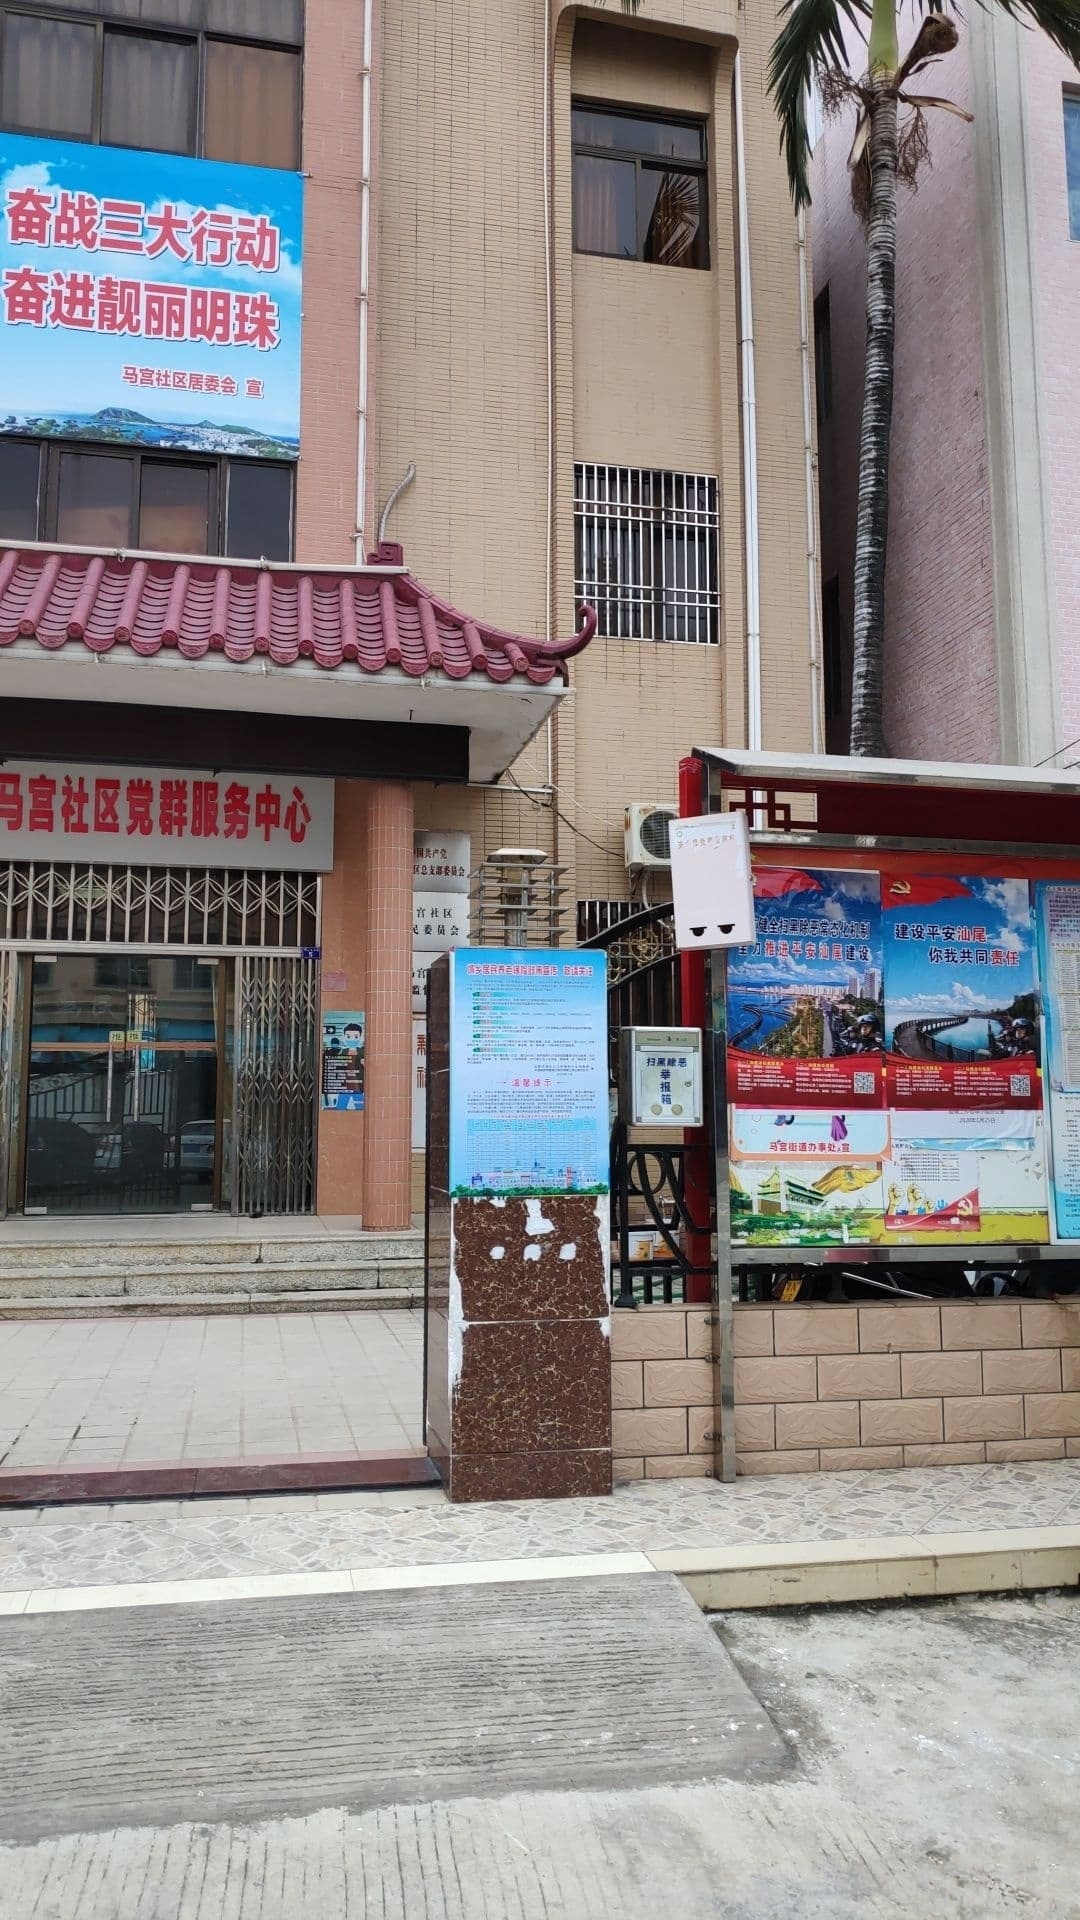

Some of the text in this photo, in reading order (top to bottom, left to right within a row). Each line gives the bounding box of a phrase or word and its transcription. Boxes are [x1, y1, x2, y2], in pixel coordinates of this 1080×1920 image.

[6, 186, 279, 271] 奋战三大行动
[3, 267, 278, 349] 奋进靓丽明珠
[122, 365, 263, 396] 马宫社区居委会 宣
[0, 773, 312, 843] 马宫社区党群服务中心
[413, 847, 448, 860] 国共产党
[894, 922, 988, 943] 建设平安汕尾
[928, 946, 1020, 966] 你我共同责任
[646, 1057, 688, 1068] 扫黑除恶
[769, 1141, 837, 1152] 马宫街道办事处
